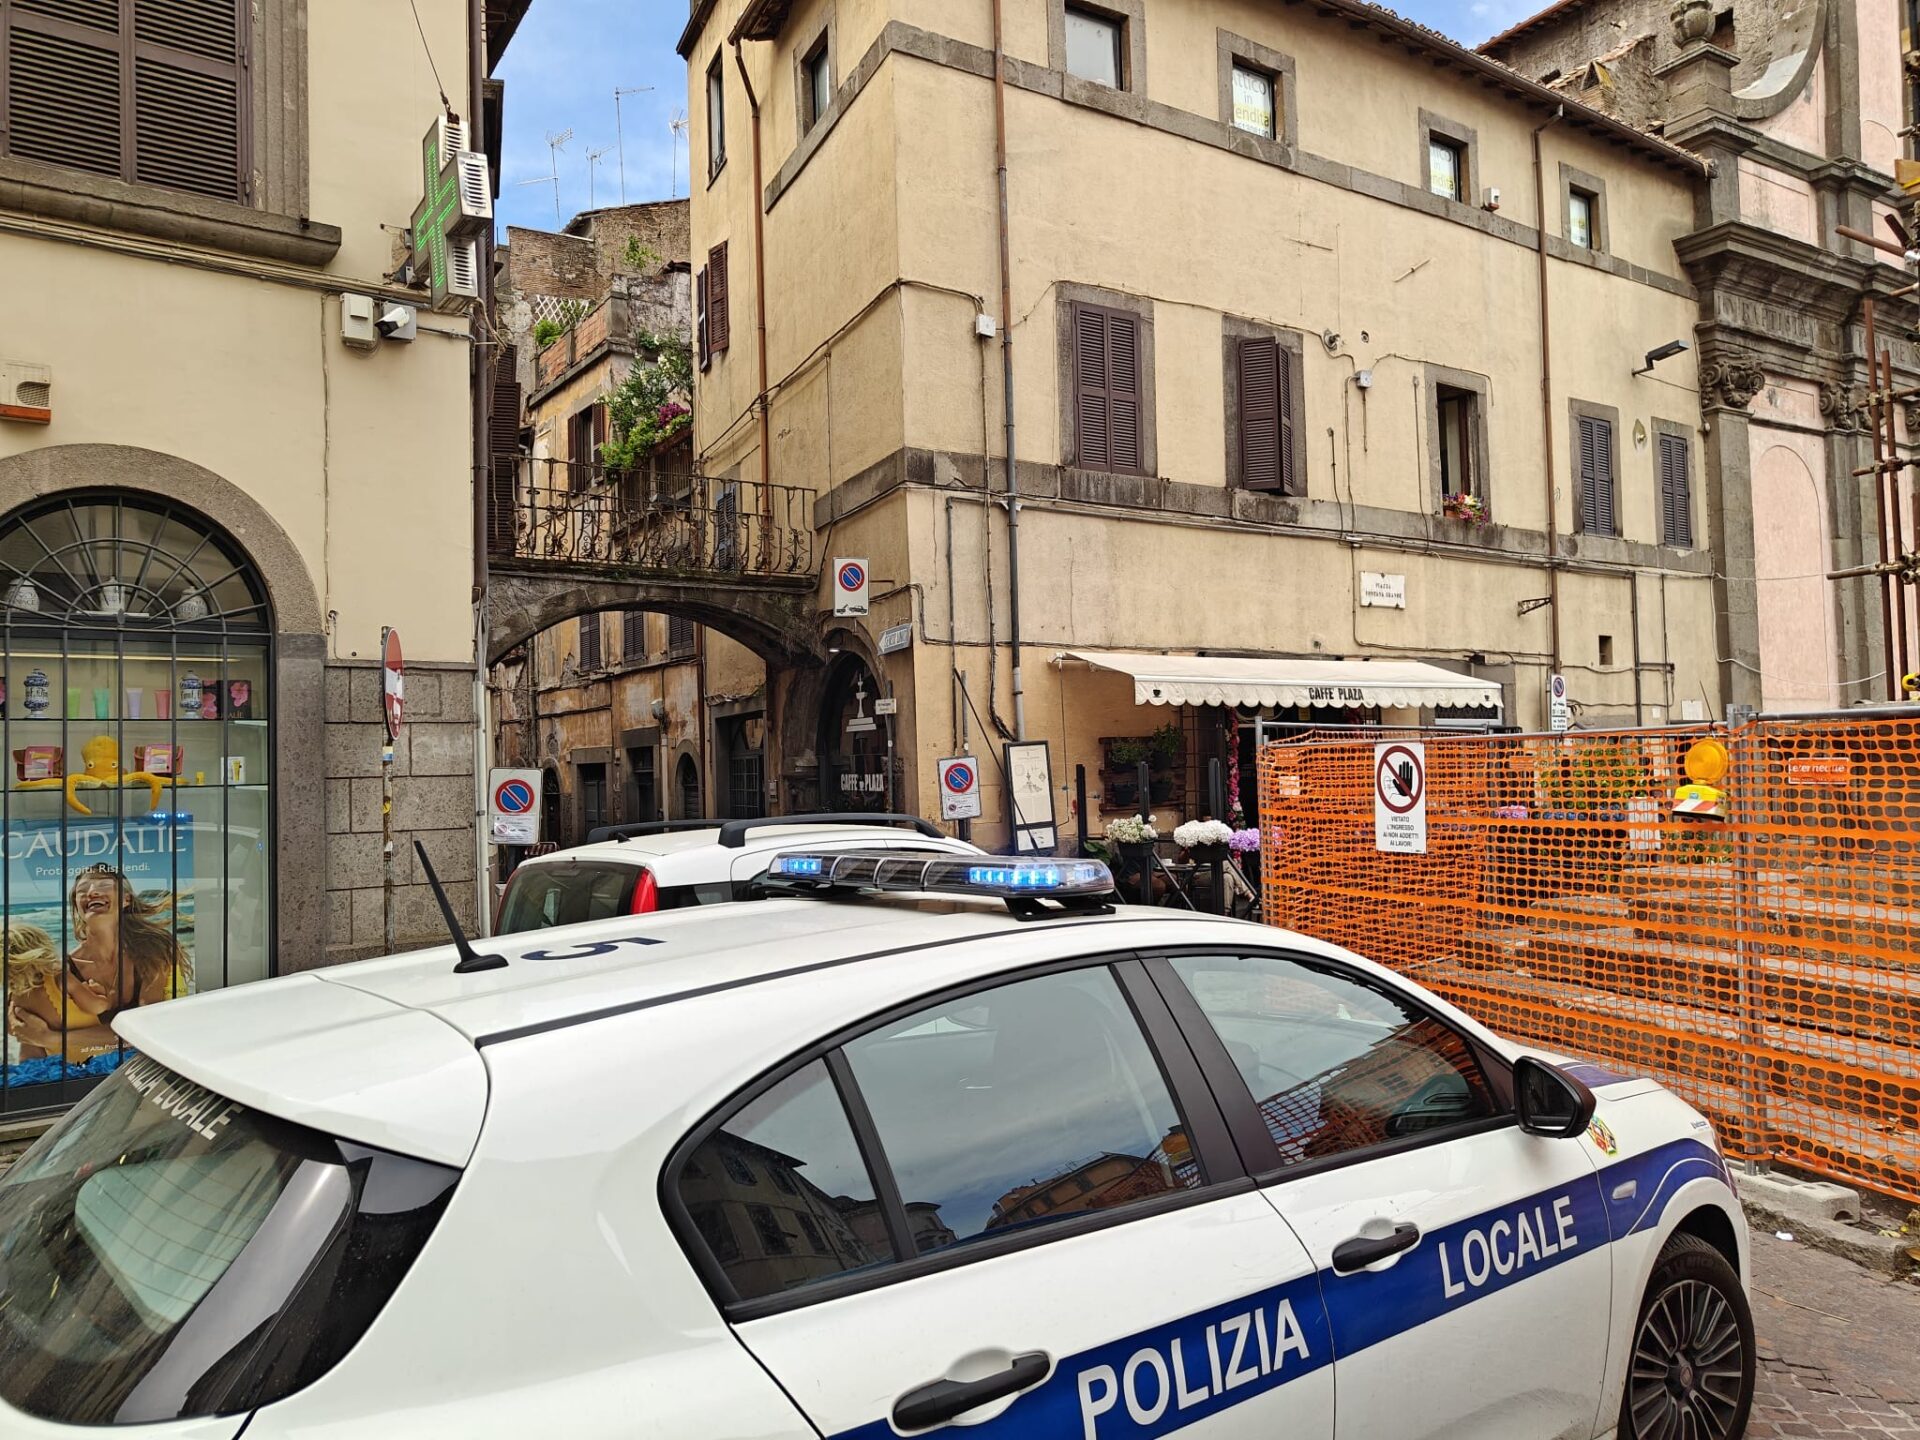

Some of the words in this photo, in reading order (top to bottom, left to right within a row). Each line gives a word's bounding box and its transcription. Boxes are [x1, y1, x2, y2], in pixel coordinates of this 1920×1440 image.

[1234, 106, 1270, 127] endita
[1338, 687, 1364, 701] PLAZA
[863, 773, 885, 792] PLAZA
[1391, 815, 1410, 823] VIETATO
[35, 865, 96, 877] Protggiti.
[152, 1076, 242, 1140] LOCALE
[1077, 1298, 1310, 1440] POLIZIA
[1438, 1195, 1578, 1298] LOCALE
